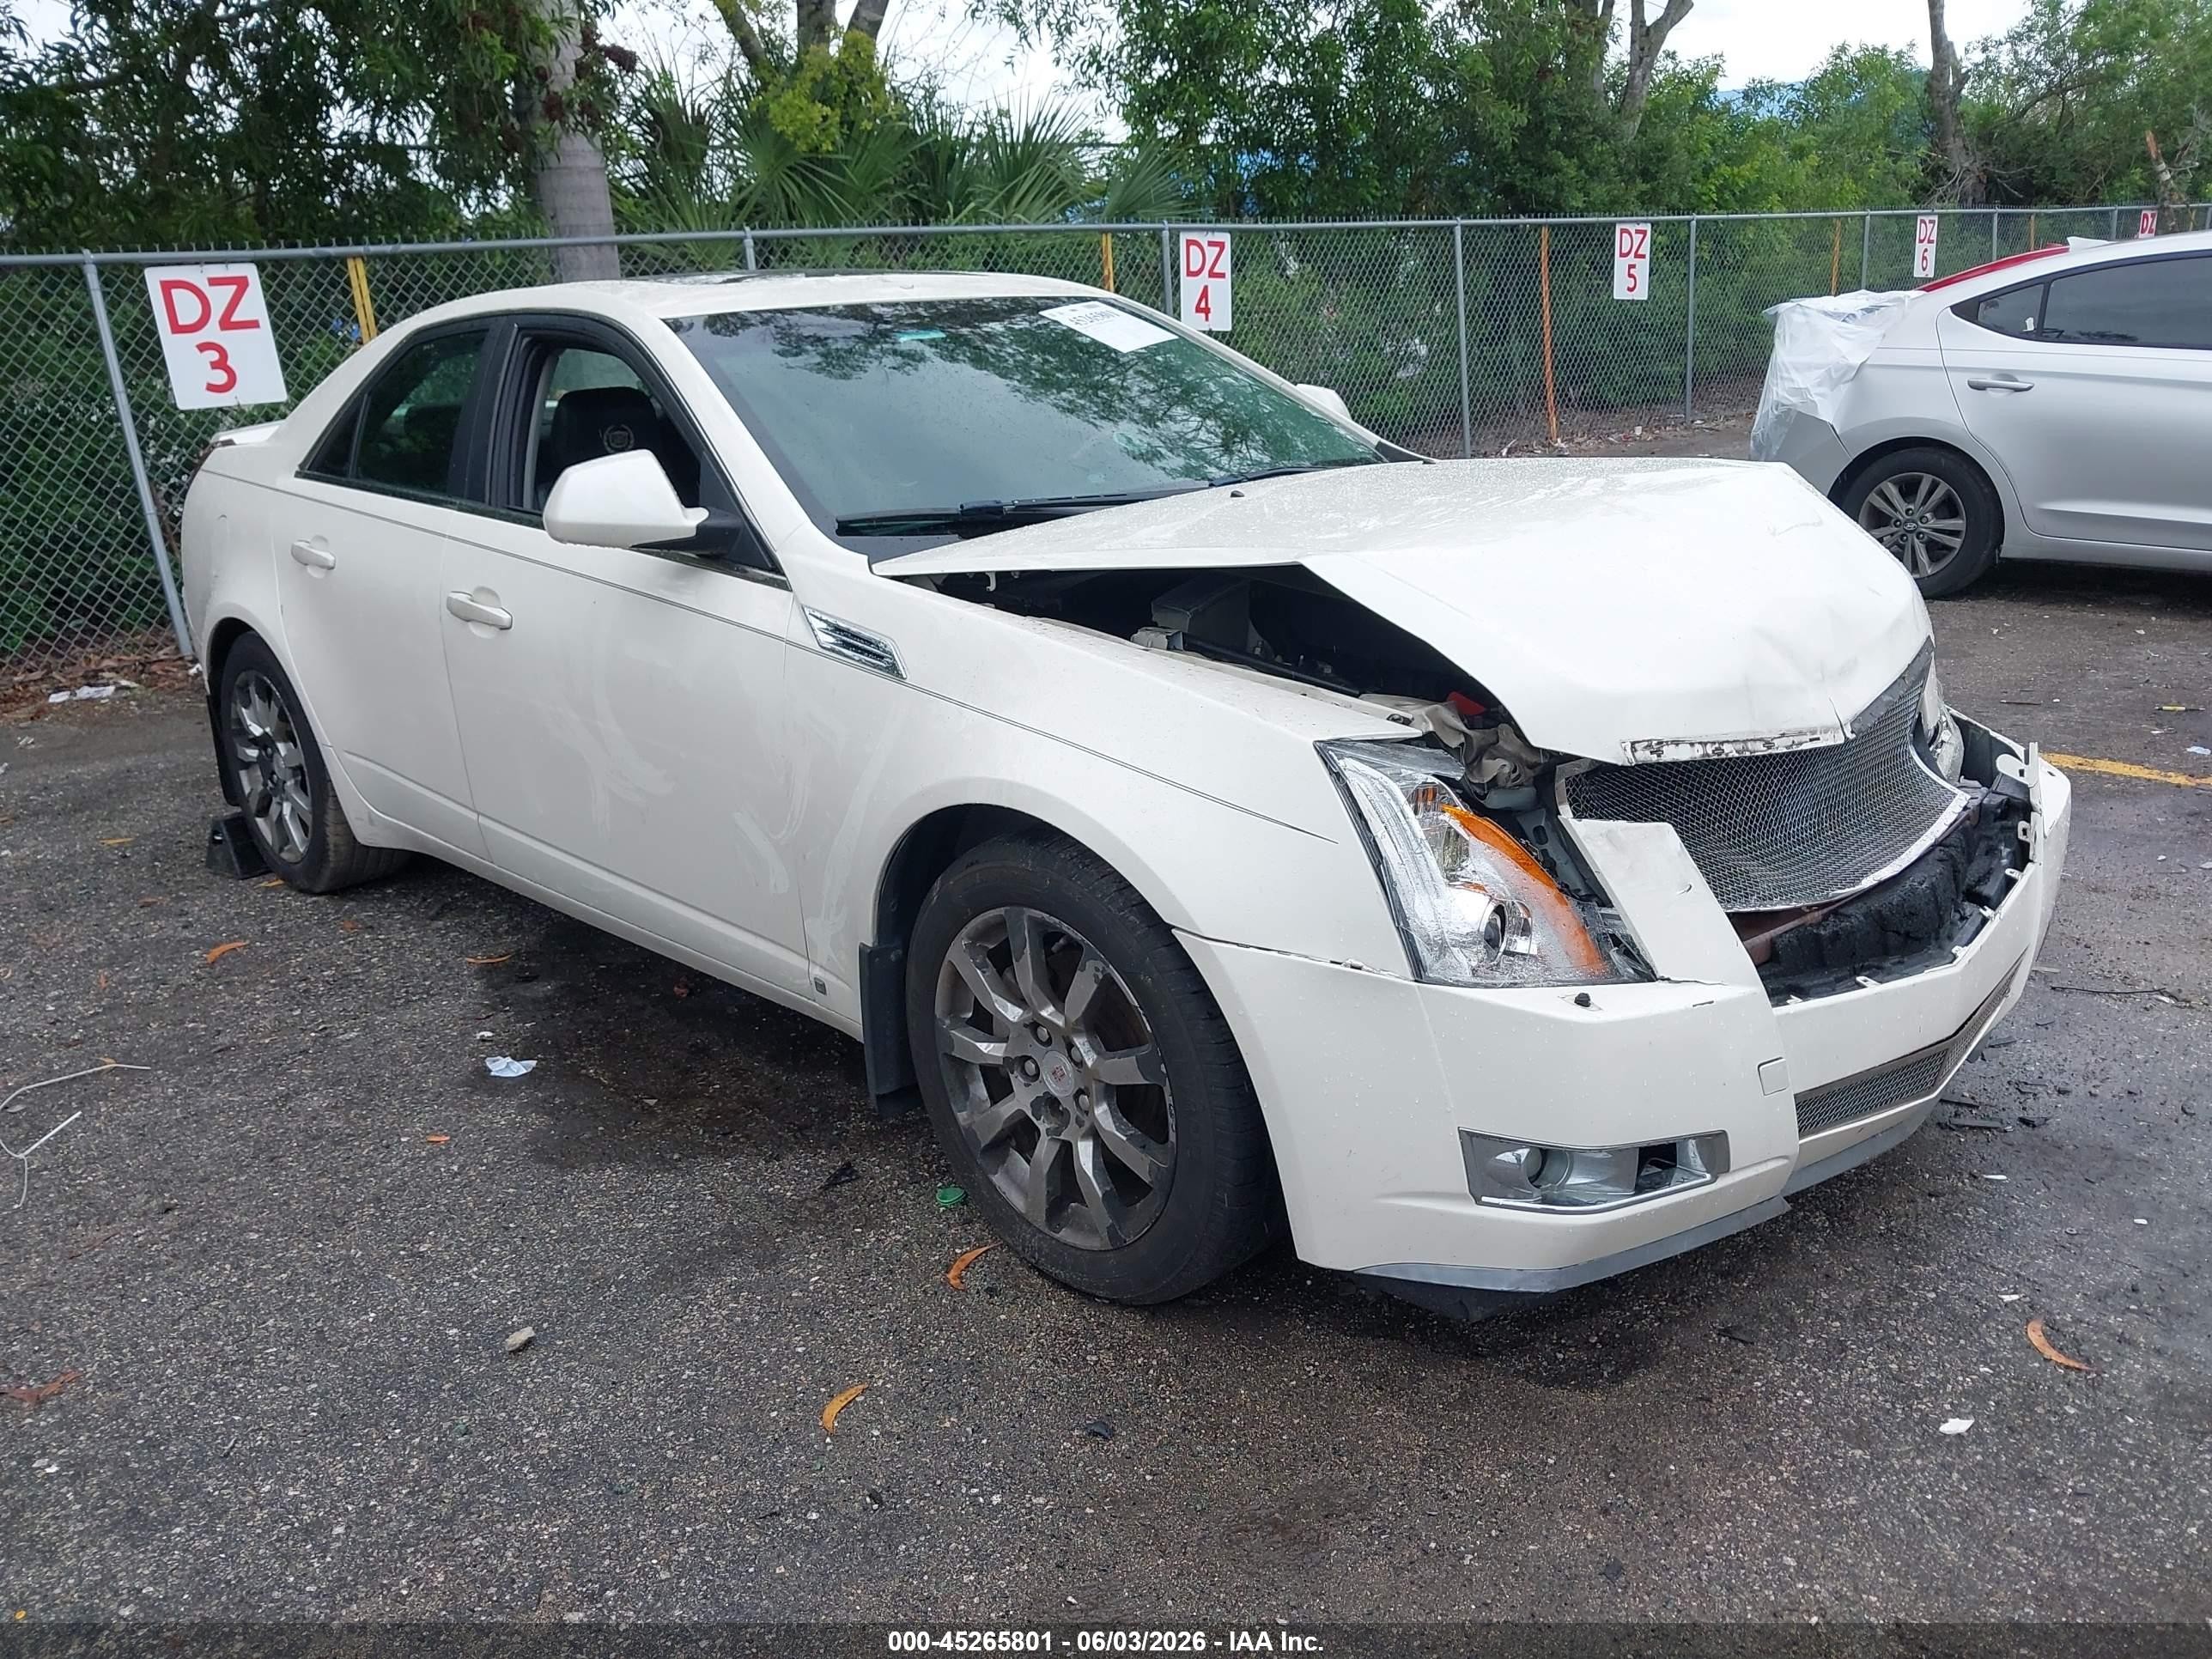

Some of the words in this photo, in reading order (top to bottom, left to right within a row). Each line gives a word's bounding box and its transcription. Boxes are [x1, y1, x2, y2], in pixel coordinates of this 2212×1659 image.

[1917, 218, 1936, 244] DZ
[2140, 212, 2156, 234] DZ
[1185, 239, 1226, 279] DZ
[1619, 228, 1648, 259] DZ
[1921, 247, 1929, 272] 6
[1626, 263, 1638, 293] 5
[160, 275, 260, 335] DZ
[1194, 284, 1211, 322] 4
[195, 340, 238, 394] 3
